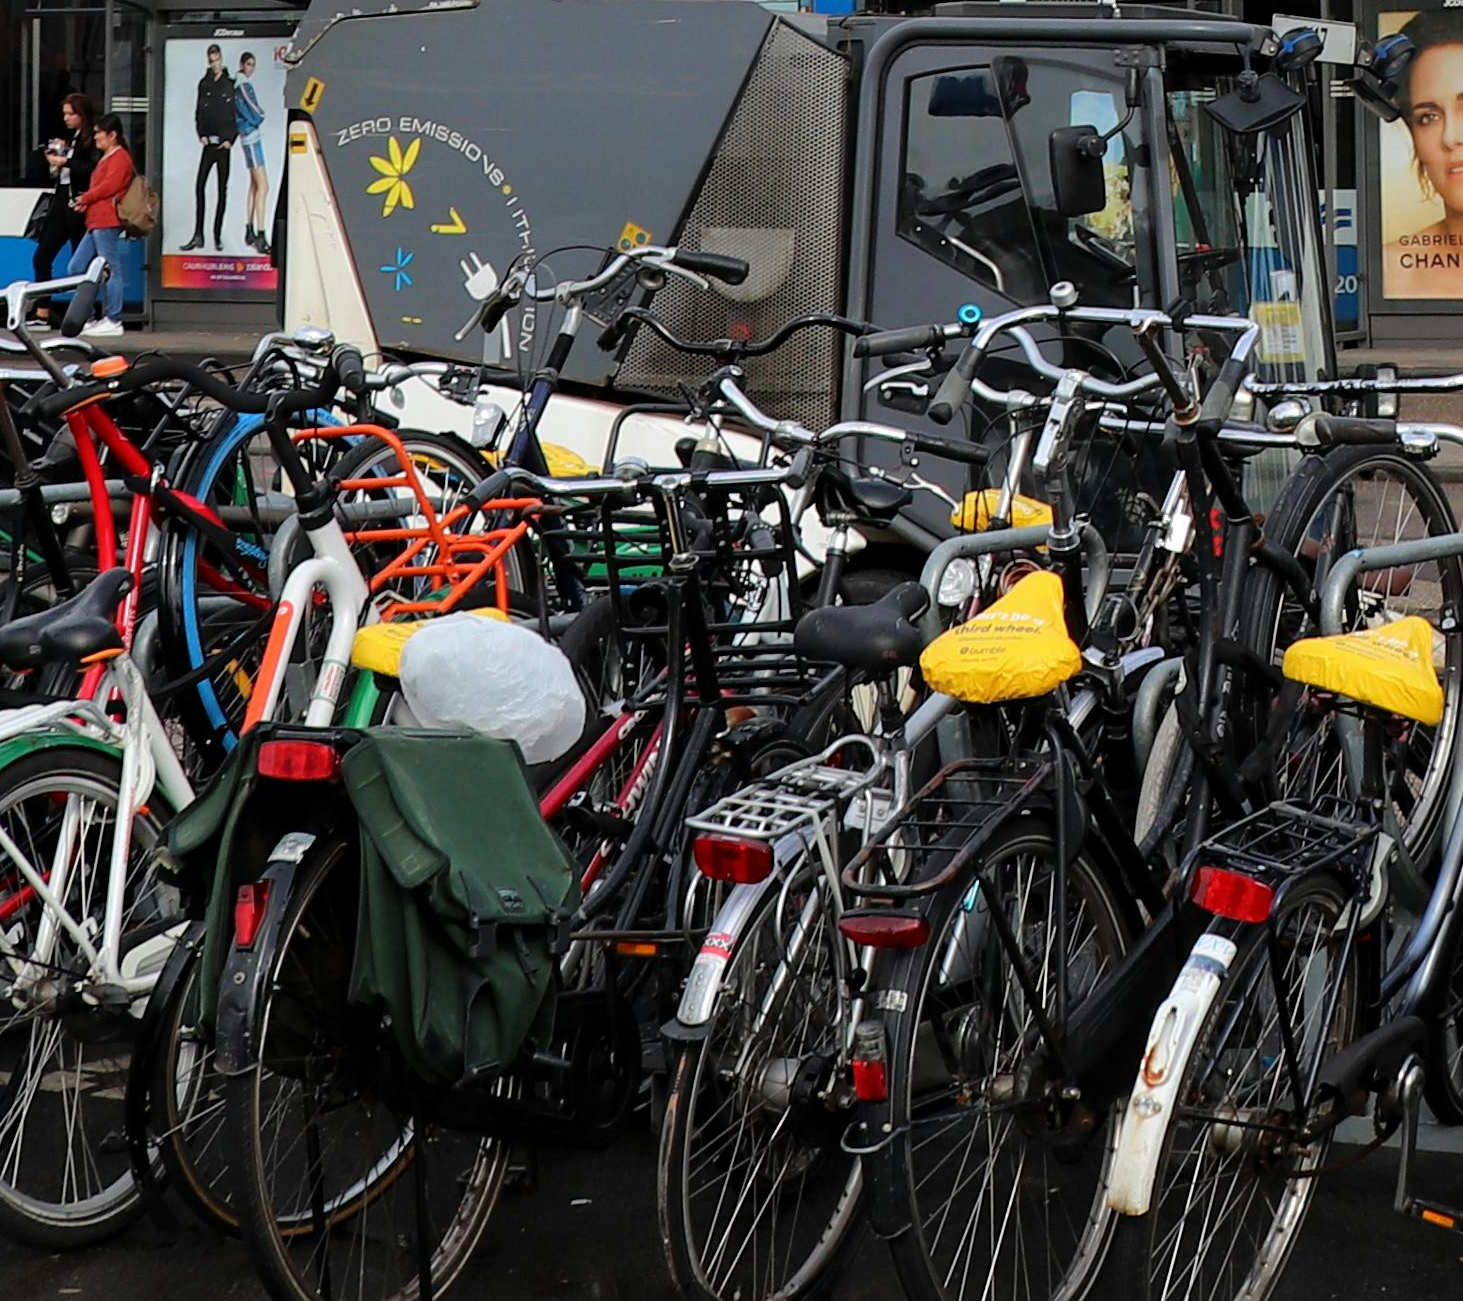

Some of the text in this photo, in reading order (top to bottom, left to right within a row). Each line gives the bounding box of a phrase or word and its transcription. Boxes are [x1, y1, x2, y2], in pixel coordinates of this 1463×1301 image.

[337, 117, 391, 146] ZERO
[399, 116, 504, 186] EMISSIONS
[519, 307, 535, 352] ION
[1335, 275, 1358, 294] 20
